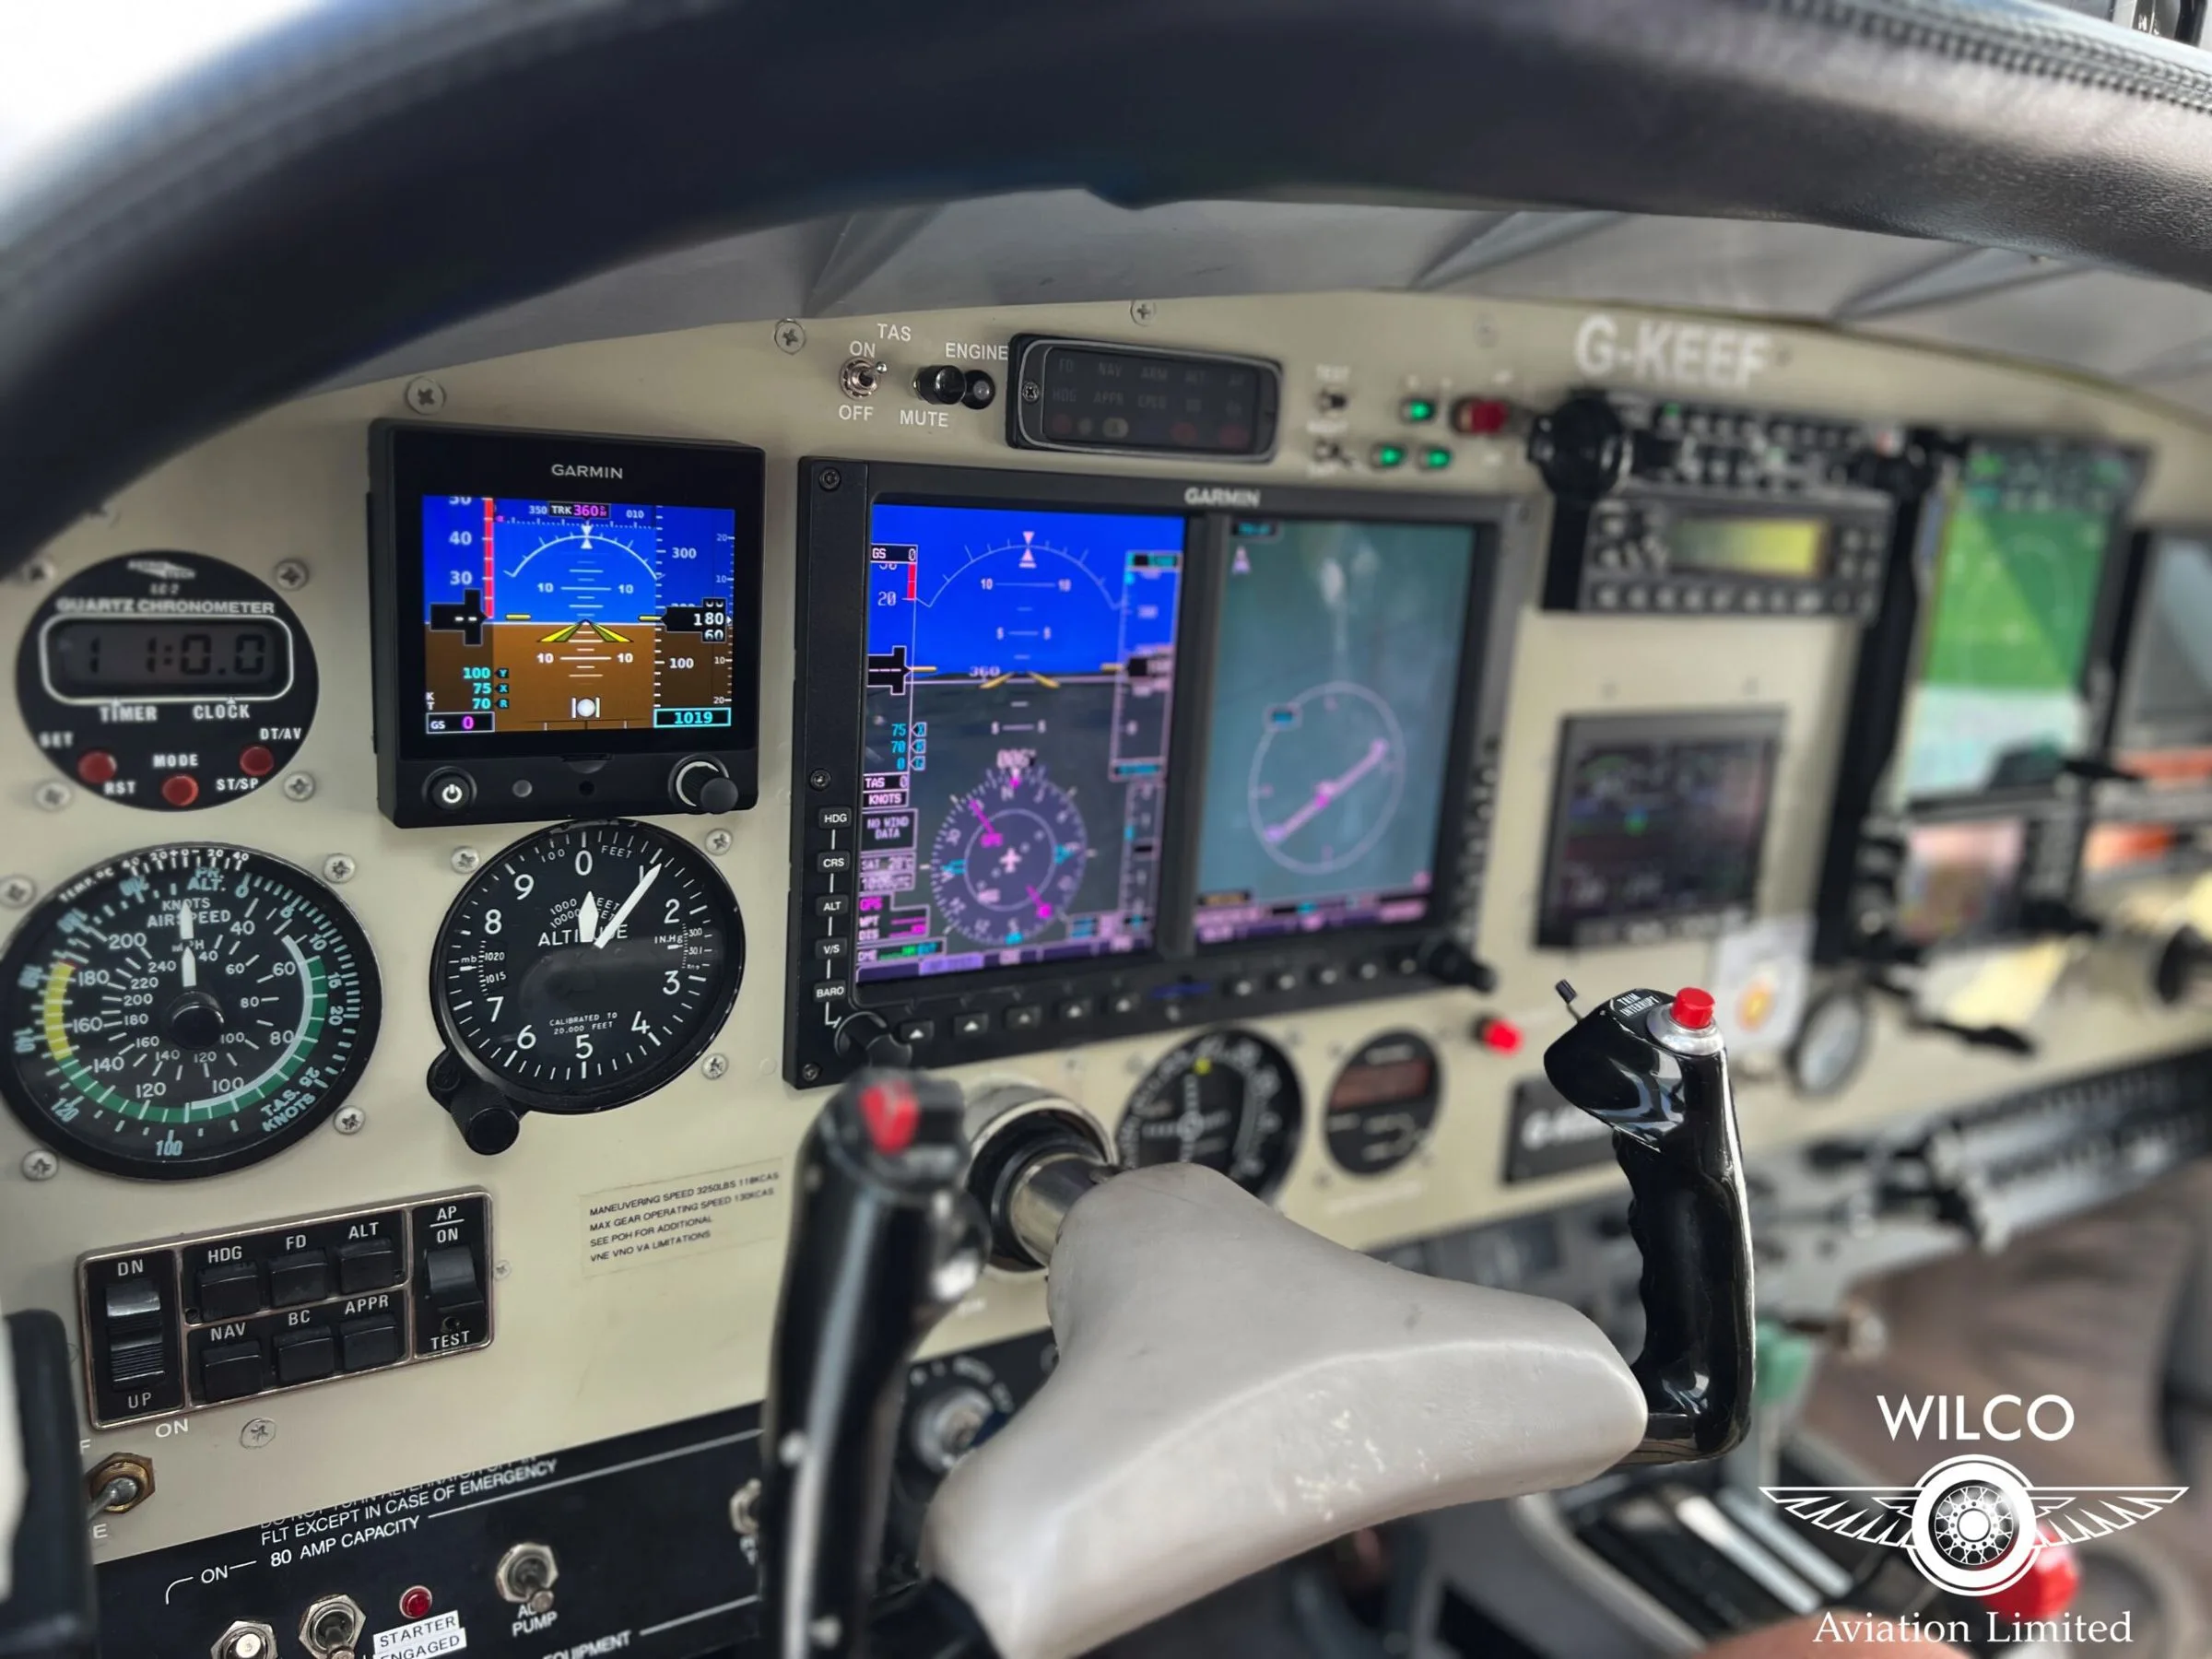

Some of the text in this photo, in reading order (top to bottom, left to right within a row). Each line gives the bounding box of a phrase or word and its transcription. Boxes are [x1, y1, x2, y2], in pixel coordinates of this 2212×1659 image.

[877, 324, 912, 341] TAS
[849, 341, 876, 358] ON
[945, 342, 1008, 360] ENGINE
[1574, 314, 1773, 388] G-KEEF
[839, 405, 874, 421] OFF
[900, 409, 949, 427] MUTE
[551, 464, 623, 479] GARMIN
[1184, 488, 1260, 508] GARMIN
[529, 506, 547, 514] 350
[552, 506, 571, 515] TRK
[573, 504, 598, 517] 360
[449, 531, 472, 546] 40
[672, 547, 697, 559] 300
[872, 548, 887, 559] GS
[450, 571, 473, 585] 30
[56, 596, 275, 615] QUARTZ CHRONOMETER
[878, 592, 897, 606] 20
[693, 612, 724, 626] 180
[536, 653, 554, 664] 10
[617, 653, 633, 664] 10
[669, 658, 694, 669] 100
[464, 667, 491, 679] 100
[473, 683, 491, 694] 75
[472, 698, 491, 710] 70
[100, 706, 158, 723] TIMER
[193, 705, 250, 720] CLOCK
[674, 712, 713, 724] 1019
[430, 716, 475, 730] GS 0
[891, 724, 906, 736] 75
[40, 733, 74, 747] SET
[260, 727, 301, 740] DT/AV
[153, 754, 198, 767] MODE
[104, 782, 135, 794] RST
[217, 778, 259, 791] ST/SP
[865, 778, 885, 788] TAS
[868, 794, 901, 805] KNOTS
[824, 814, 848, 823] HDG
[541, 845, 632, 863] 100 FEET
[575, 850, 593, 876] 0
[823, 858, 844, 868] CRS
[187, 877, 227, 892] ALT.
[514, 874, 535, 900] 9
[550, 898, 577, 915] 1000
[664, 899, 680, 924] 2
[823, 901, 841, 912] ALT
[230, 921, 255, 935] 40
[484, 908, 502, 935] 8
[109, 933, 147, 950] 200
[198, 950, 218, 961] 40
[485, 952, 505, 961] 1020
[823, 944, 840, 955] V/S
[148, 960, 176, 973] 240
[226, 963, 244, 974] 60
[273, 961, 296, 976] 60
[79, 970, 110, 986] 180
[131, 977, 159, 990] 220
[486, 971, 506, 983] 1015
[662, 971, 680, 995] 3
[817, 986, 844, 998] BARO
[1617, 993, 1641, 1006] TRIM
[124, 994, 153, 1006] 200
[241, 996, 259, 1008] 80
[487, 996, 504, 1022] 7
[73, 1017, 102, 1033] 160
[124, 1014, 148, 1025] 180
[549, 1014, 599, 1027] CALIBRATED
[592, 1021, 614, 1030] FEET
[630, 1011, 650, 1034] 4
[136, 1036, 159, 1048] 160
[220, 1032, 244, 1043] 100
[269, 1030, 295, 1045] 80
[517, 1024, 536, 1049] 6
[576, 1033, 594, 1059] 5
[156, 1050, 180, 1061] 140
[194, 1051, 218, 1063] 120
[94, 1056, 124, 1073] 140
[136, 1082, 167, 1100] 120
[212, 1077, 244, 1094] 100
[262, 1092, 316, 1132] KNOTS
[590, 1195, 661, 1217] MANEUVERING
[663, 1189, 694, 1202] SPEED
[697, 1180, 736, 1195] 3250LBS
[437, 1206, 458, 1221] AP
[590, 1221, 611, 1231] MAX
[614, 1215, 641, 1227] GEAR
[643, 1203, 699, 1221] OPERATING
[700, 1195, 731, 1209] SPEED
[347, 1221, 380, 1240] ALT
[436, 1228, 458, 1244] ON
[590, 1216, 712, 1247] SEE POH FOR ADDITIONAL
[286, 1234, 307, 1251] FD
[590, 1230, 711, 1262] VNE VNO VA LIMITATIONS
[207, 1245, 243, 1262] HDG
[117, 1259, 144, 1277] DN
[345, 1294, 389, 1315] APPR
[288, 1310, 311, 1326] BC
[210, 1322, 246, 1342] NAV
[430, 1330, 471, 1350] TEST
[127, 1392, 152, 1409] UP
[155, 1418, 189, 1438] ON
[261, 1459, 558, 1546] FLT EXCEPT IN CASE OF EMERGENCY
[270, 1515, 420, 1567] 80 AMP CAPACITY
[201, 1565, 229, 1583] ON
[512, 1611, 558, 1637] PUMP
[380, 1616, 456, 1648] STARTER
